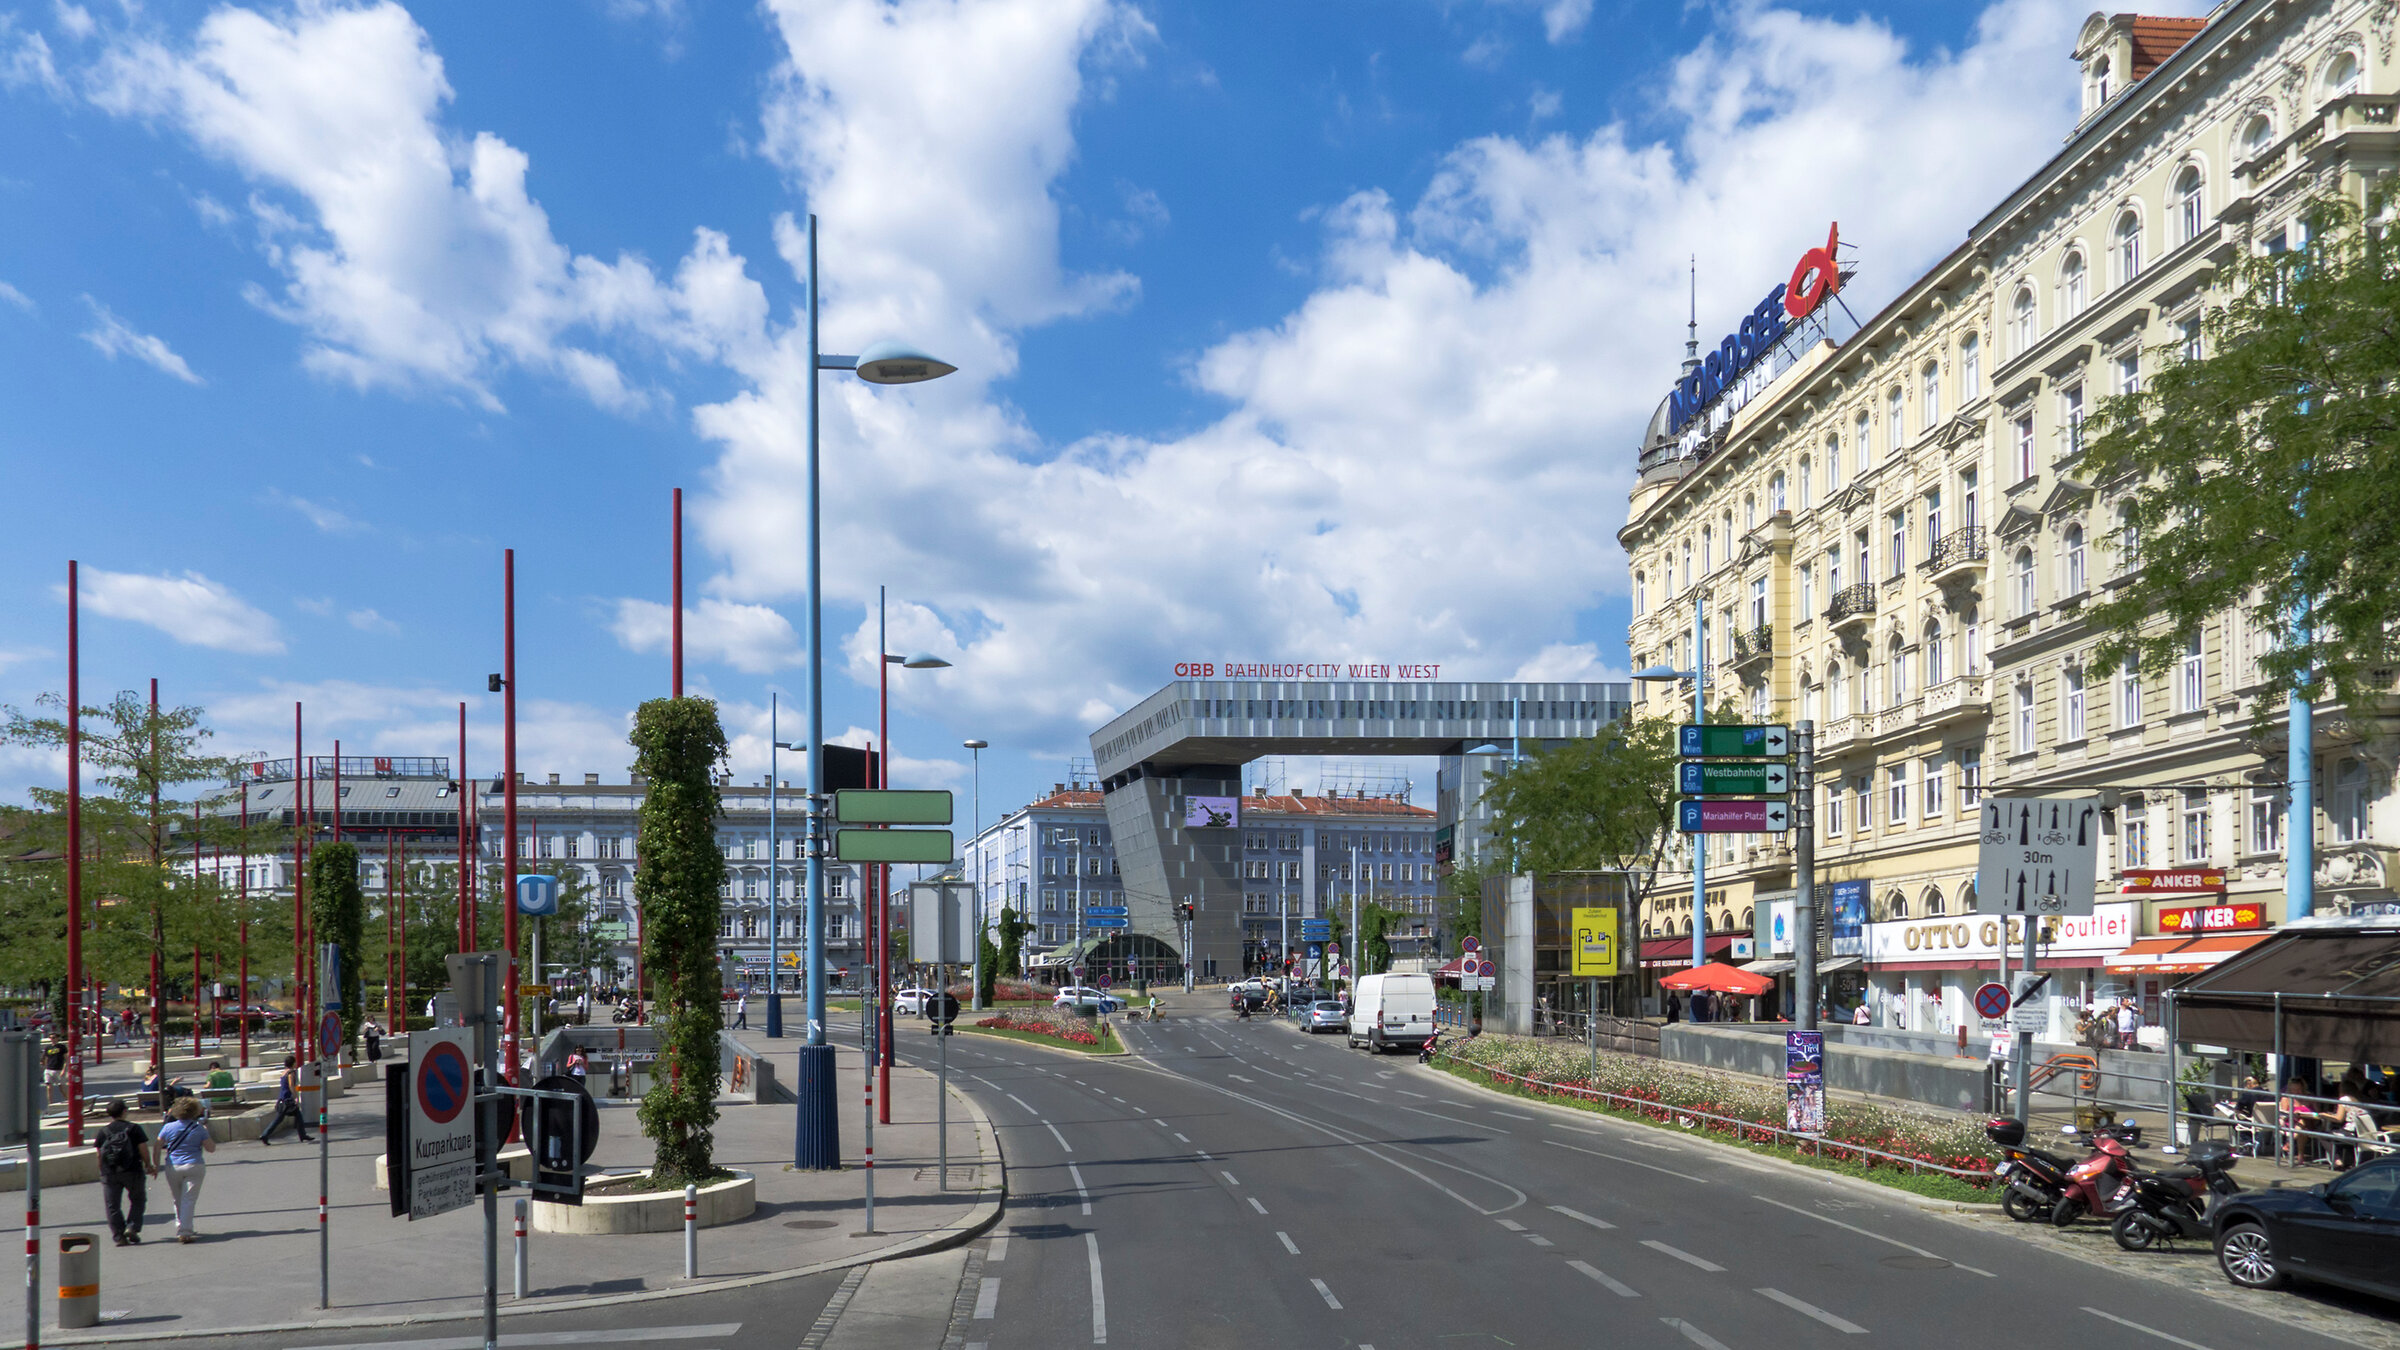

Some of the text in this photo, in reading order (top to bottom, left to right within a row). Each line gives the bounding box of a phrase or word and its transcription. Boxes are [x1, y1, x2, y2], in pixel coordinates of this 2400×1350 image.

[1670, 283, 1786, 435] NORDSEE
[1732, 354, 1775, 412] WIEN
[1174, 662, 1441, 679] ÖBB BAHNHOFCITY WIEN WEST
[1683, 744, 1702, 753] Wien
[1704, 767, 1765, 777] Westbahnhof
[1703, 811, 1743, 820] Mariahilfer
[1744, 811, 1765, 820] Platzl
[2023, 851, 2053, 863] 30m
[2152, 874, 2202, 888] ANKER
[521, 883, 546, 909] U
[2180, 907, 2235, 928] ANKER
[1904, 913, 2127, 950] OTTO GRF outlet
[415, 1132, 472, 1160] Kurzparkzone
